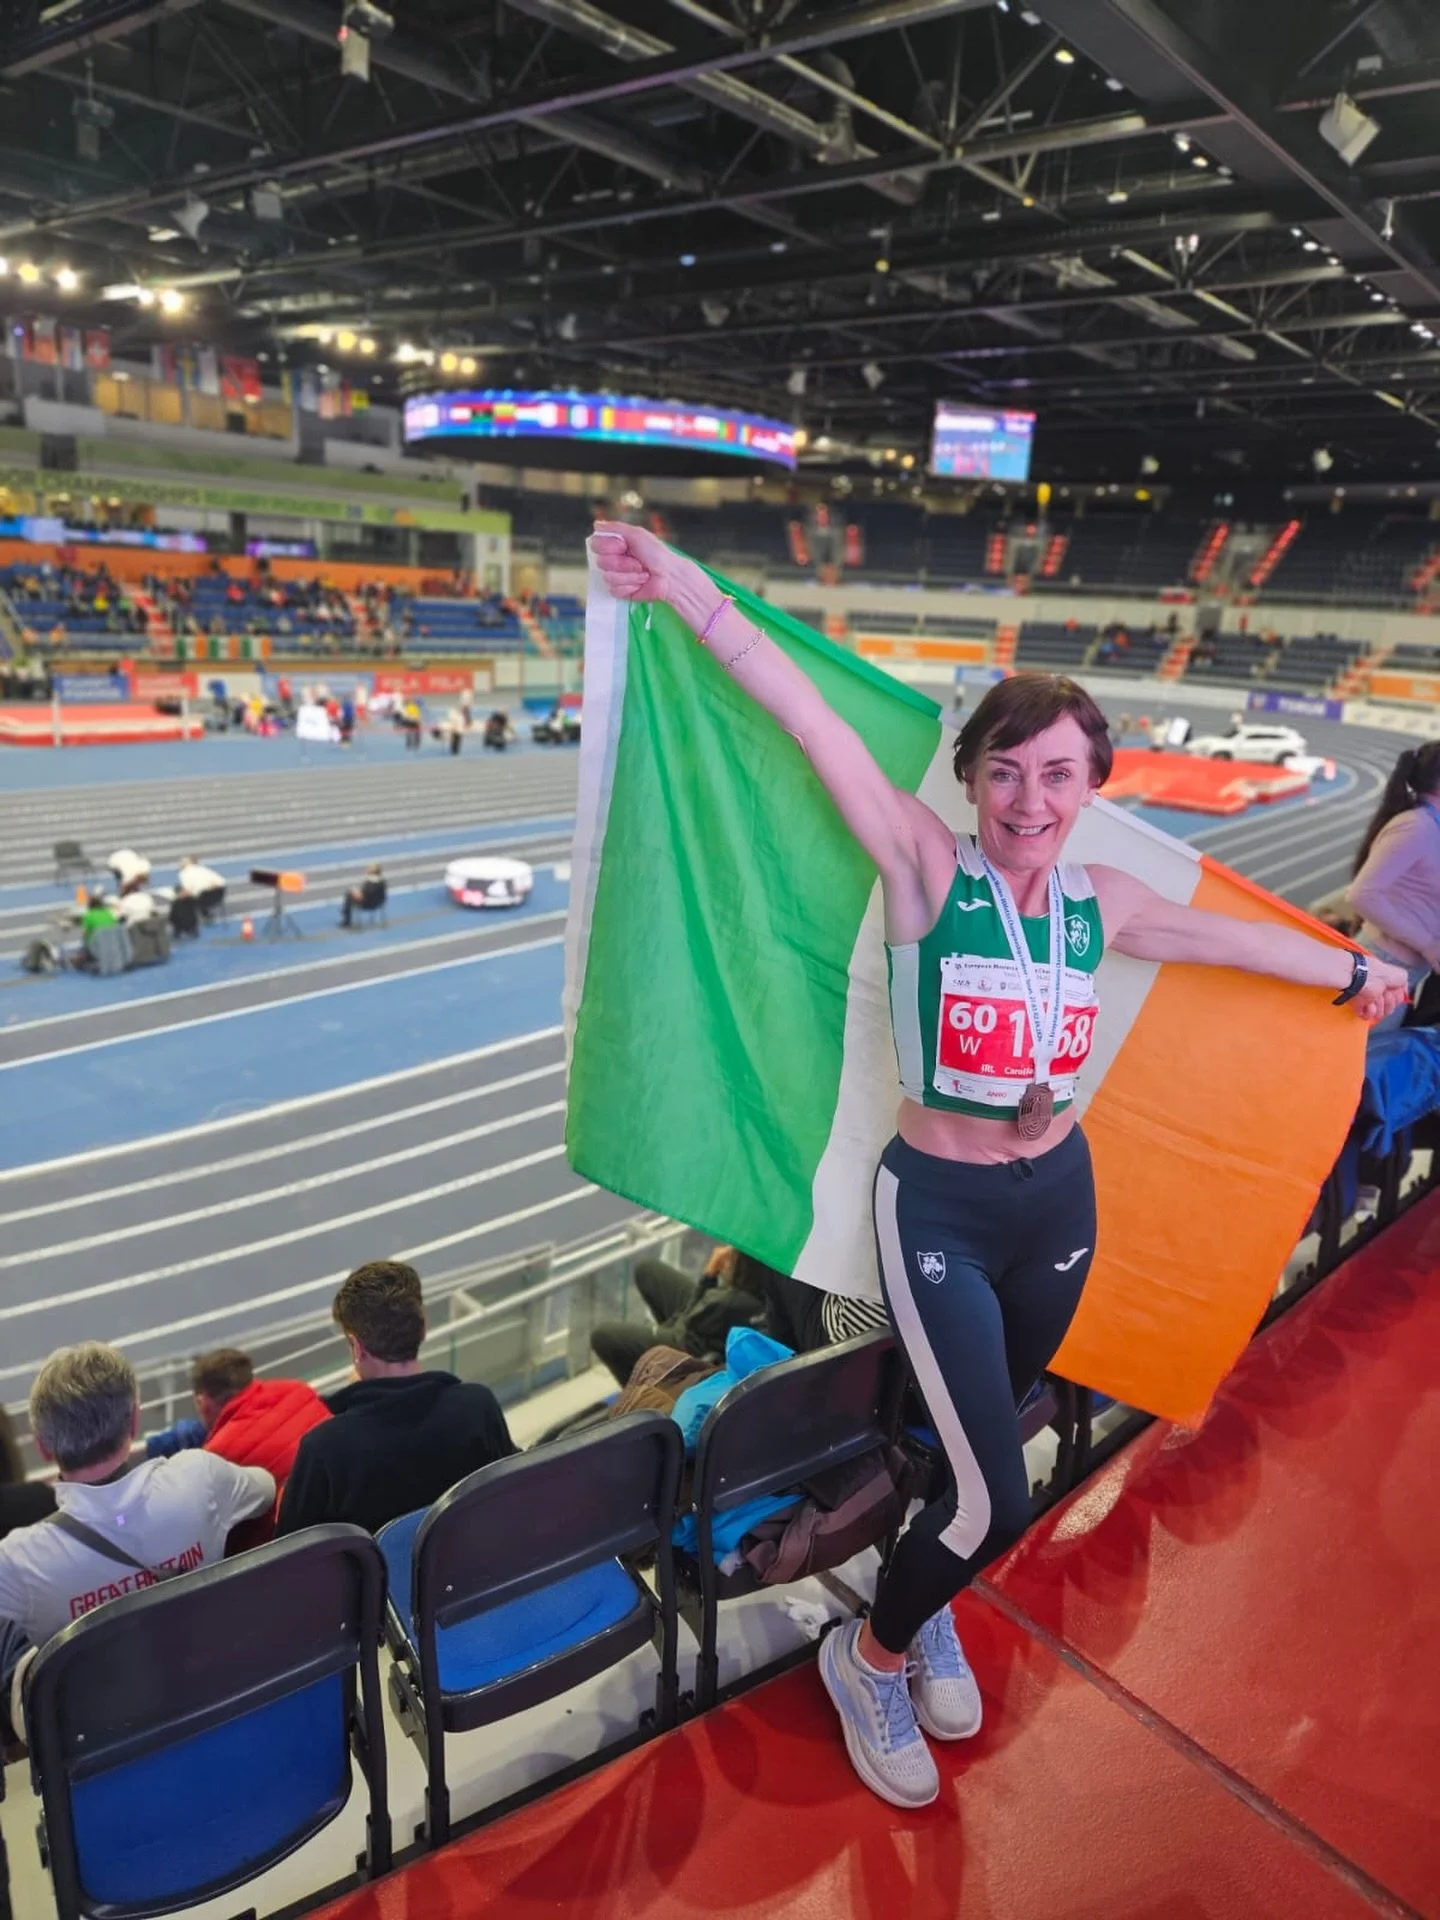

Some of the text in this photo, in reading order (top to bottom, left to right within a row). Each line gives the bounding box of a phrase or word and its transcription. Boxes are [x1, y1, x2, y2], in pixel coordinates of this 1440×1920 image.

[949, 1001, 997, 1034] 60
[1009, 1009, 1091, 1058] 168
[960, 1034, 982, 1056] W
[69, 1576, 132, 1619] GREAT
